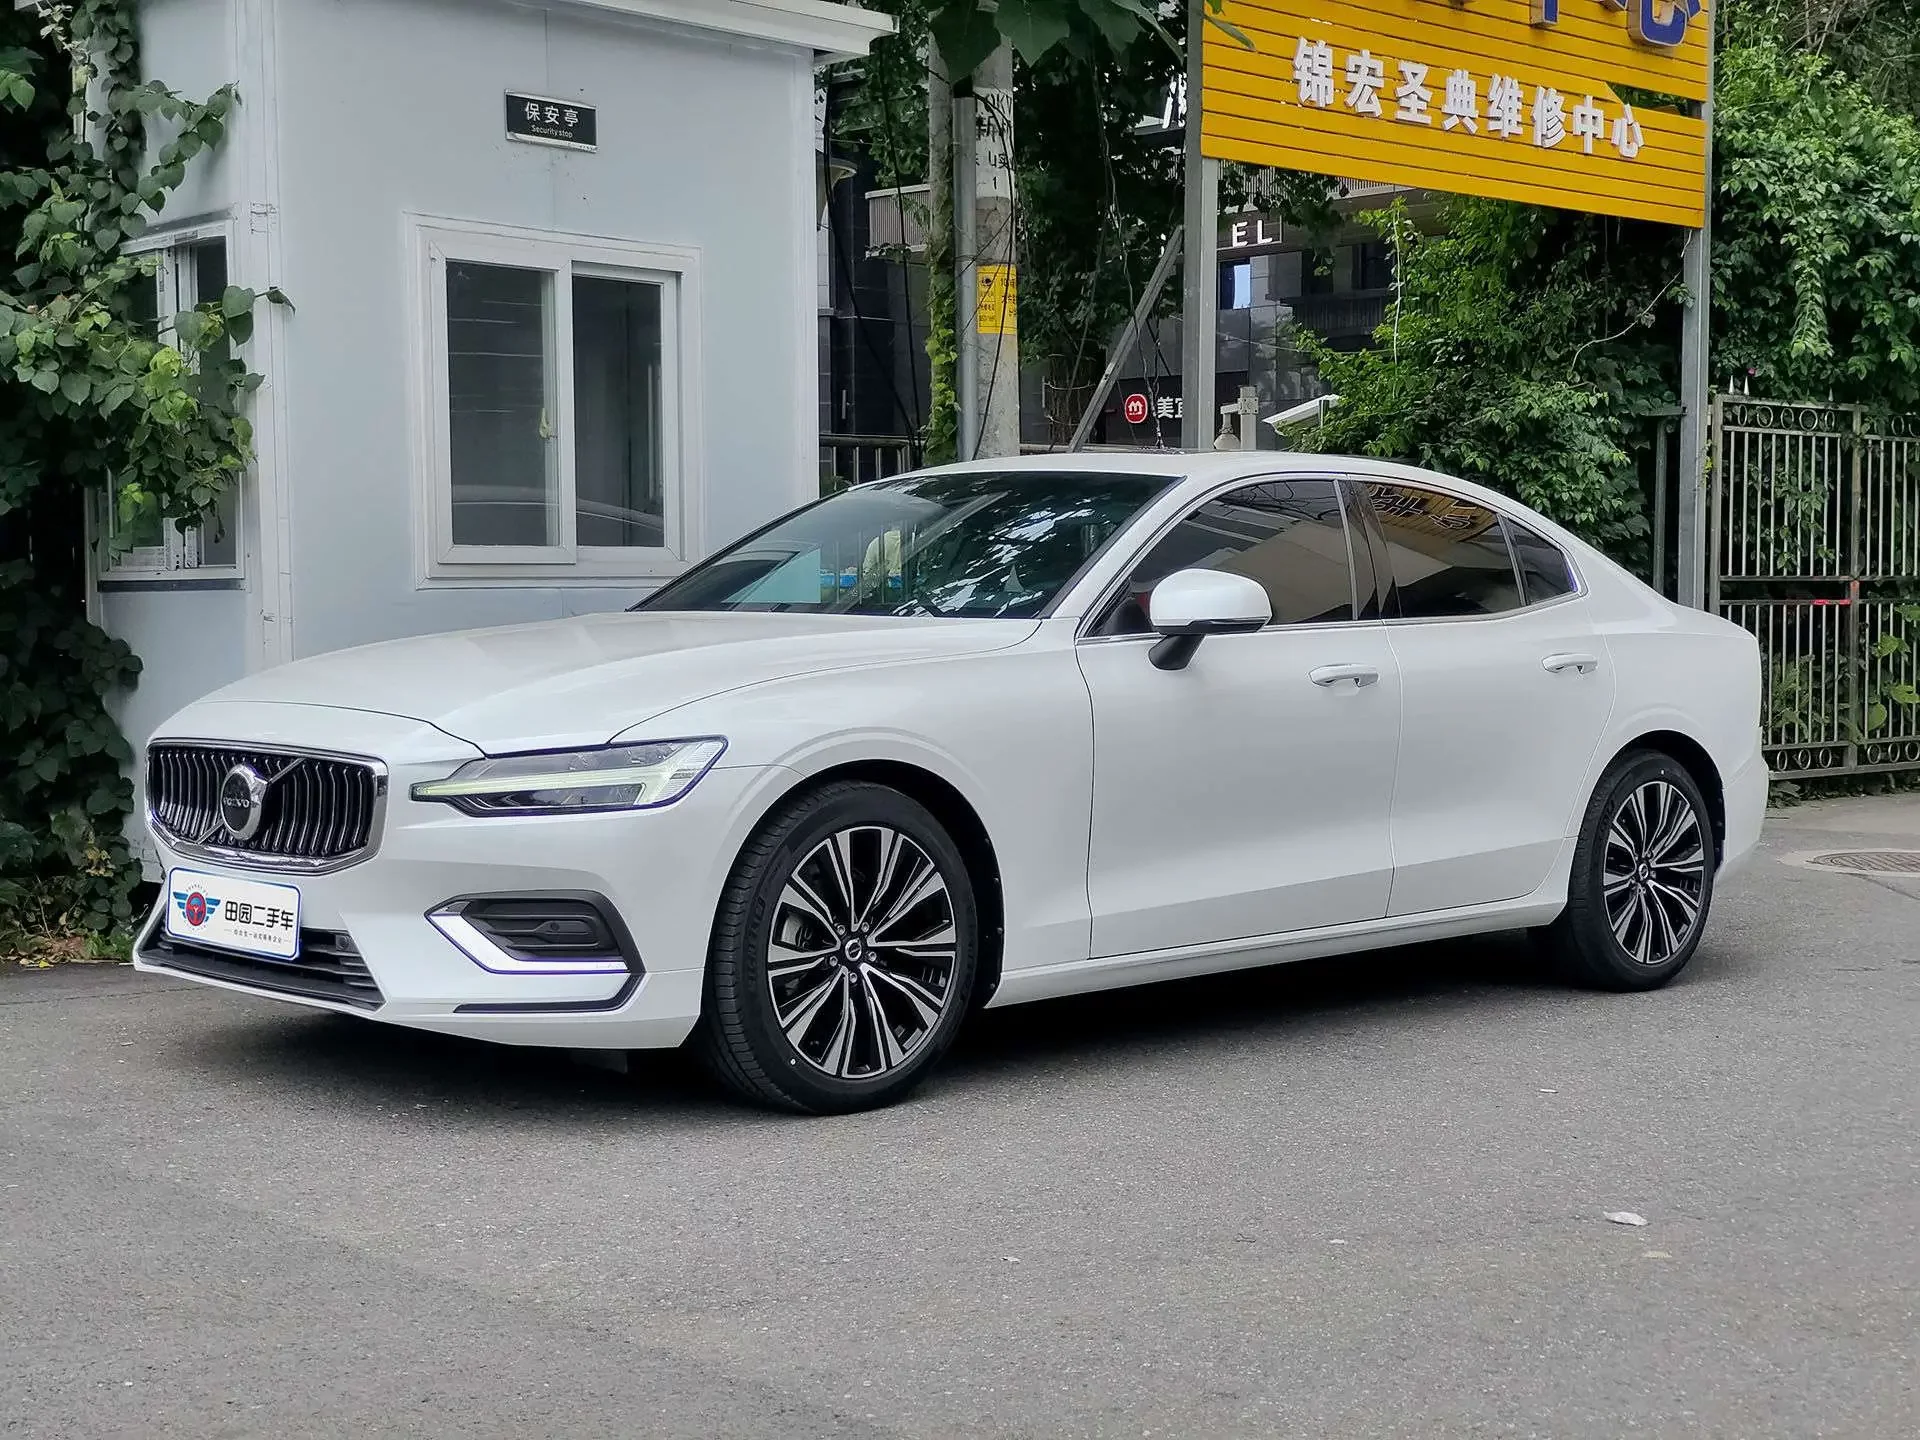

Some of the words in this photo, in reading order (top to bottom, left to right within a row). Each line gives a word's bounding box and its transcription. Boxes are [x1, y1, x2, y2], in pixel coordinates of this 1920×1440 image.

[1293, 36, 1645, 158] 锦宏圣典维修中心
[525, 101, 579, 127] 保安亭
[531, 124, 558, 136] Security
[558, 129, 573, 138] stop
[224, 900, 294, 931] 田园二手车
